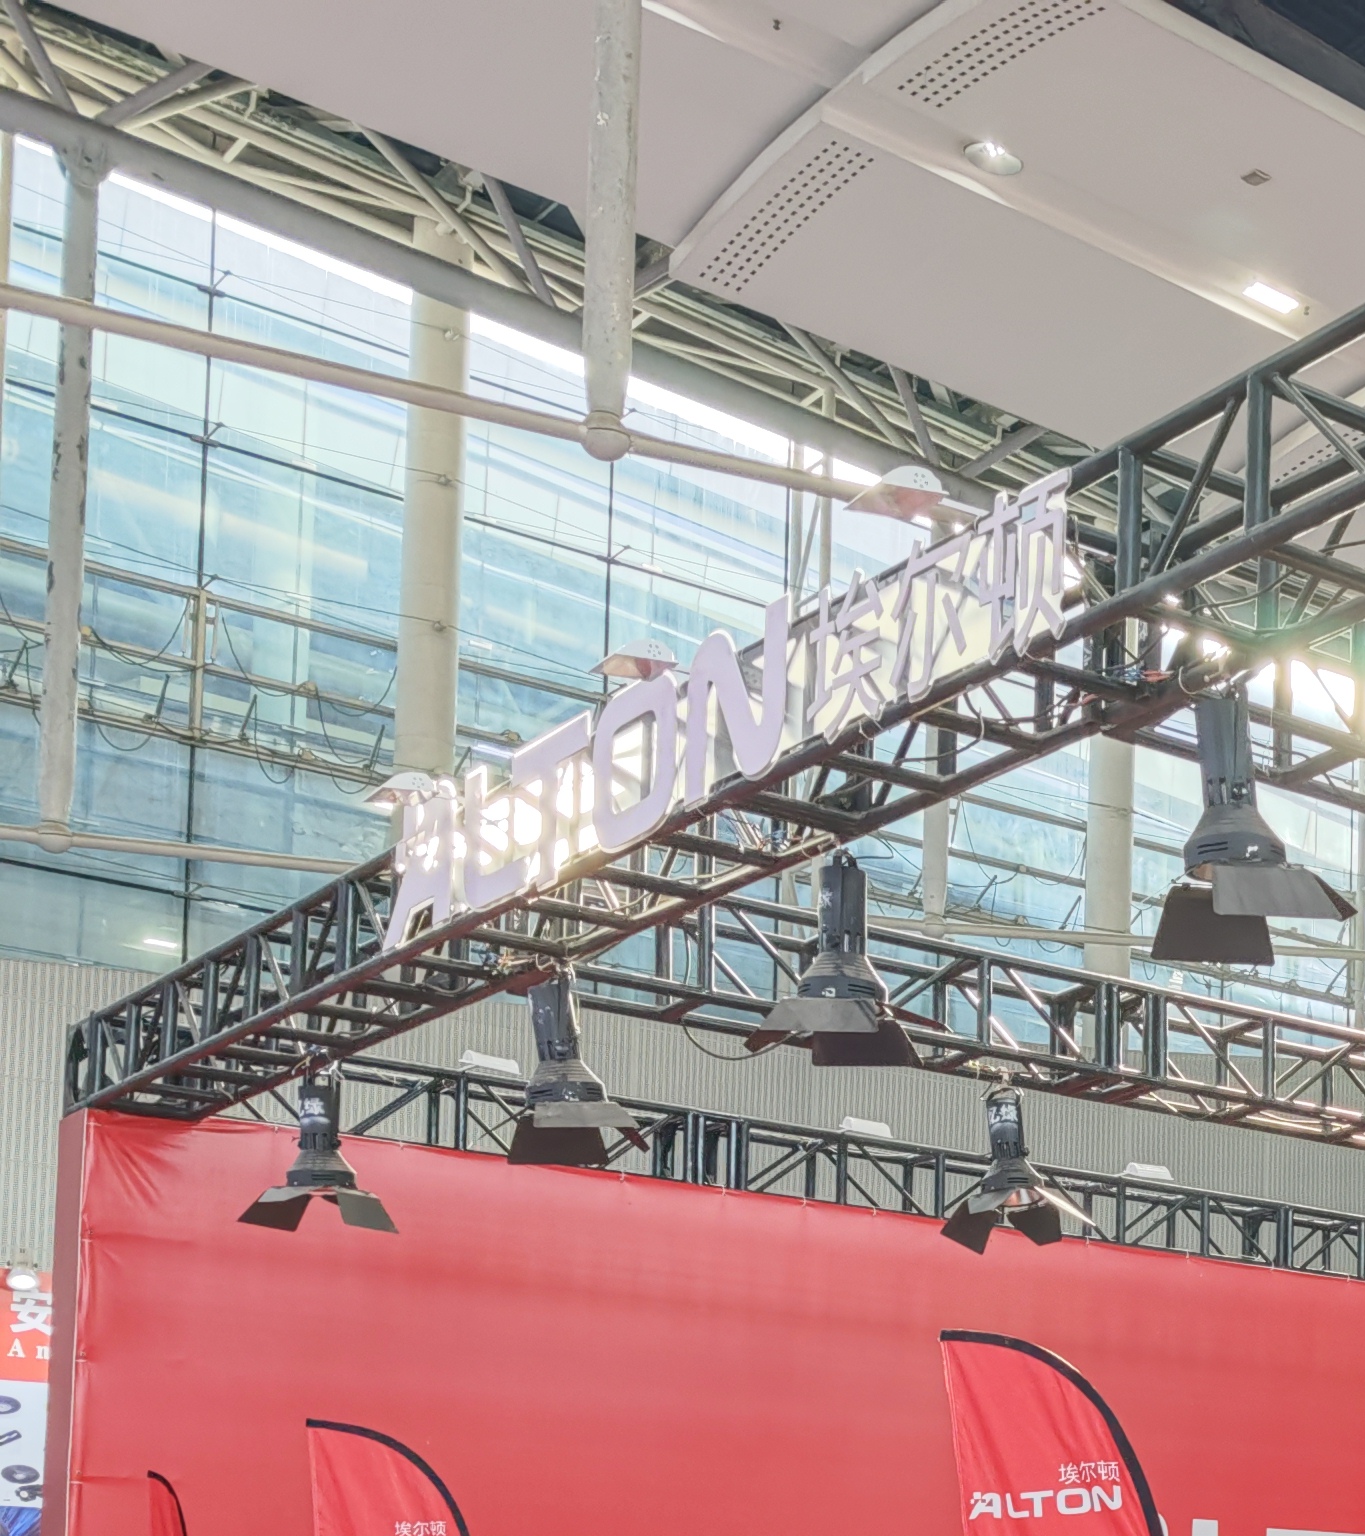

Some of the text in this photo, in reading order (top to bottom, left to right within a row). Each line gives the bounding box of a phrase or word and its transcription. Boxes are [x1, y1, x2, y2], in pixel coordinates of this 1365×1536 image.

[382, 467, 1072, 953] ALTON 埃尔顿
[1058, 1460, 1120, 1484] 埃尔顿
[969, 1485, 1122, 1520] ALTON
[394, 1521, 447, 1536] 埃尔顿
